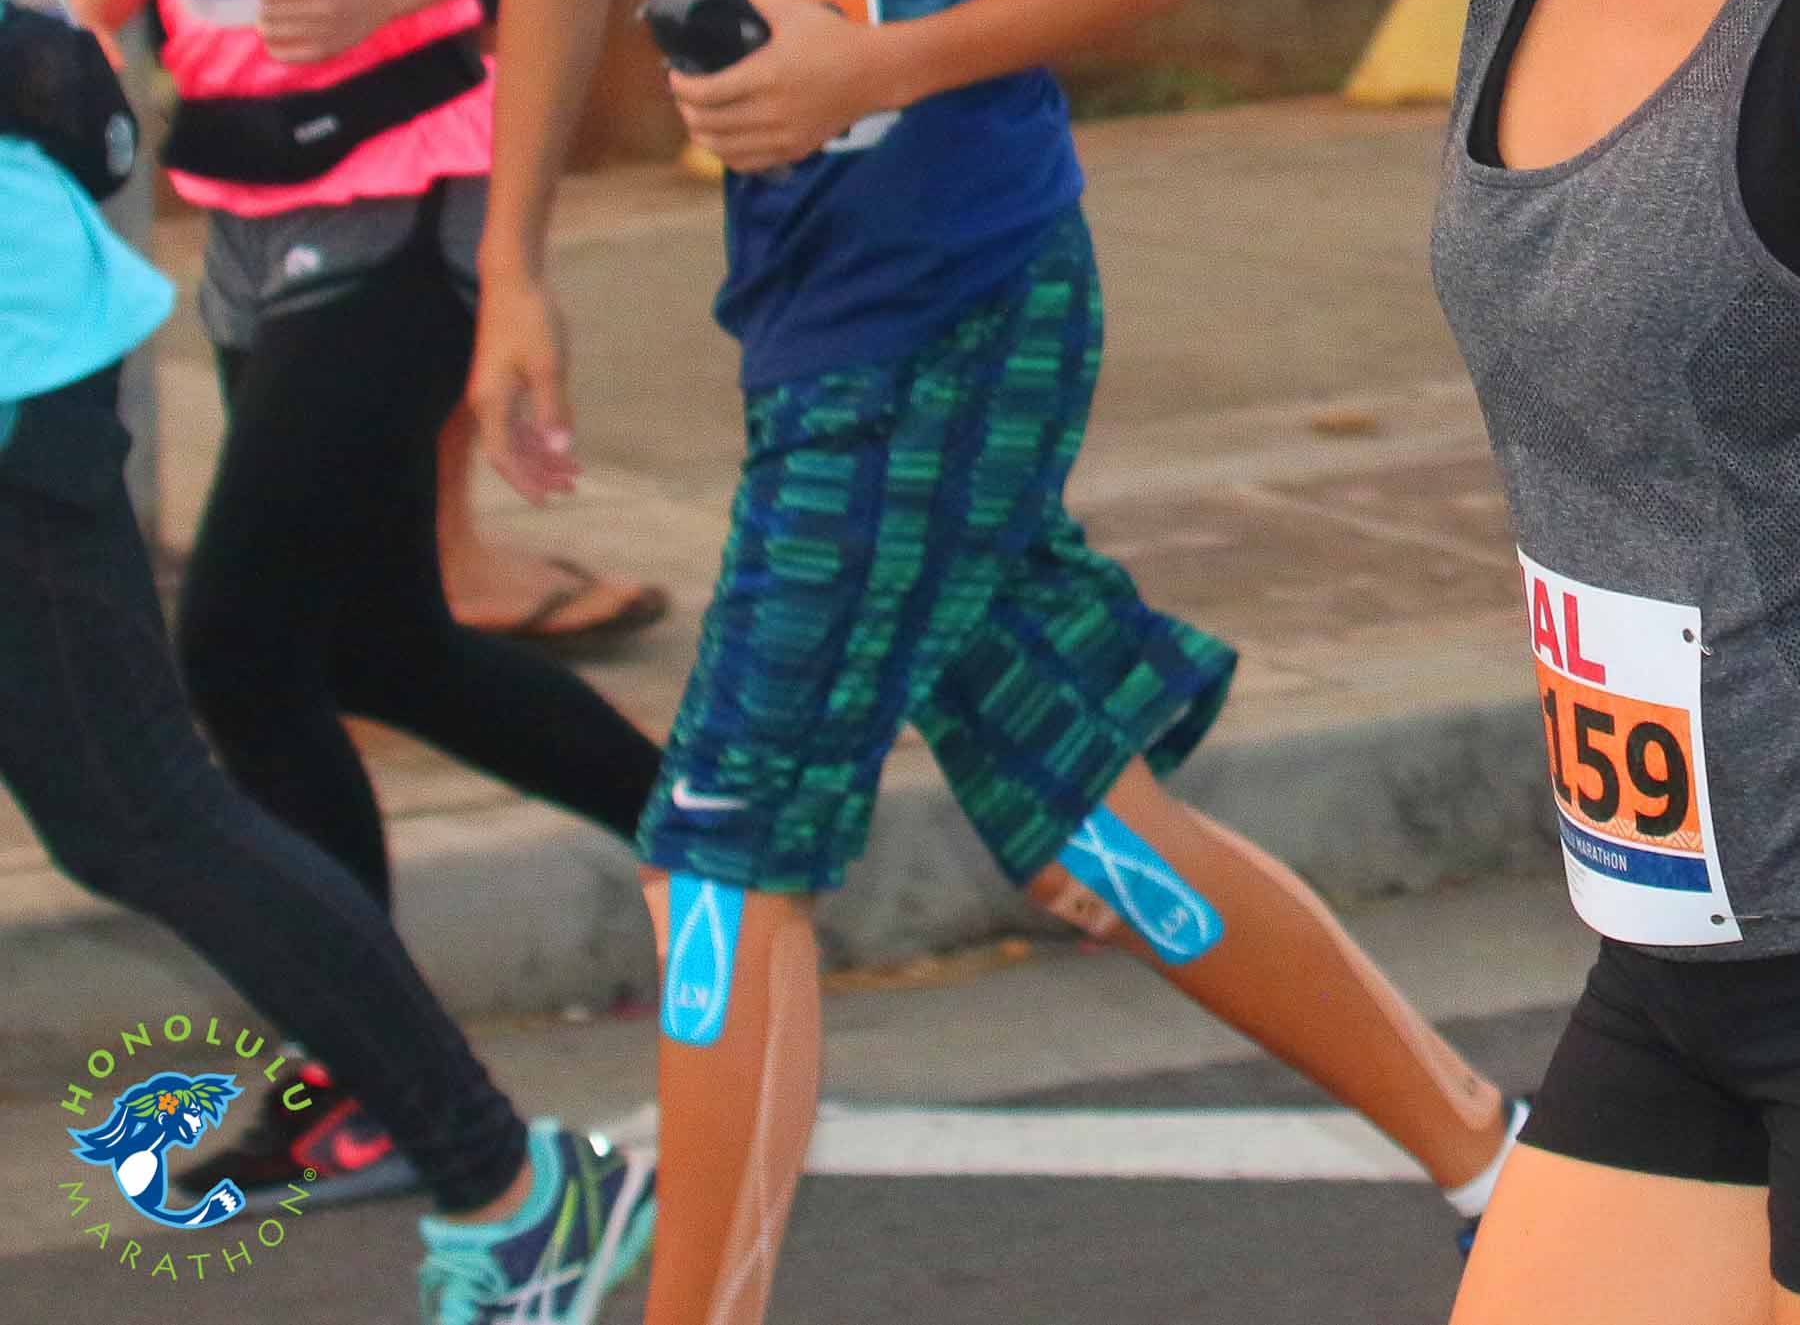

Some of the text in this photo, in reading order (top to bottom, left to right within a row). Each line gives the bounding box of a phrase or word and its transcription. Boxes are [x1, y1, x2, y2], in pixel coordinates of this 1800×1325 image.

[1520, 563, 1607, 686] AL
[1543, 685, 1690, 837] 159
[1575, 835, 1628, 872] MARATHON
